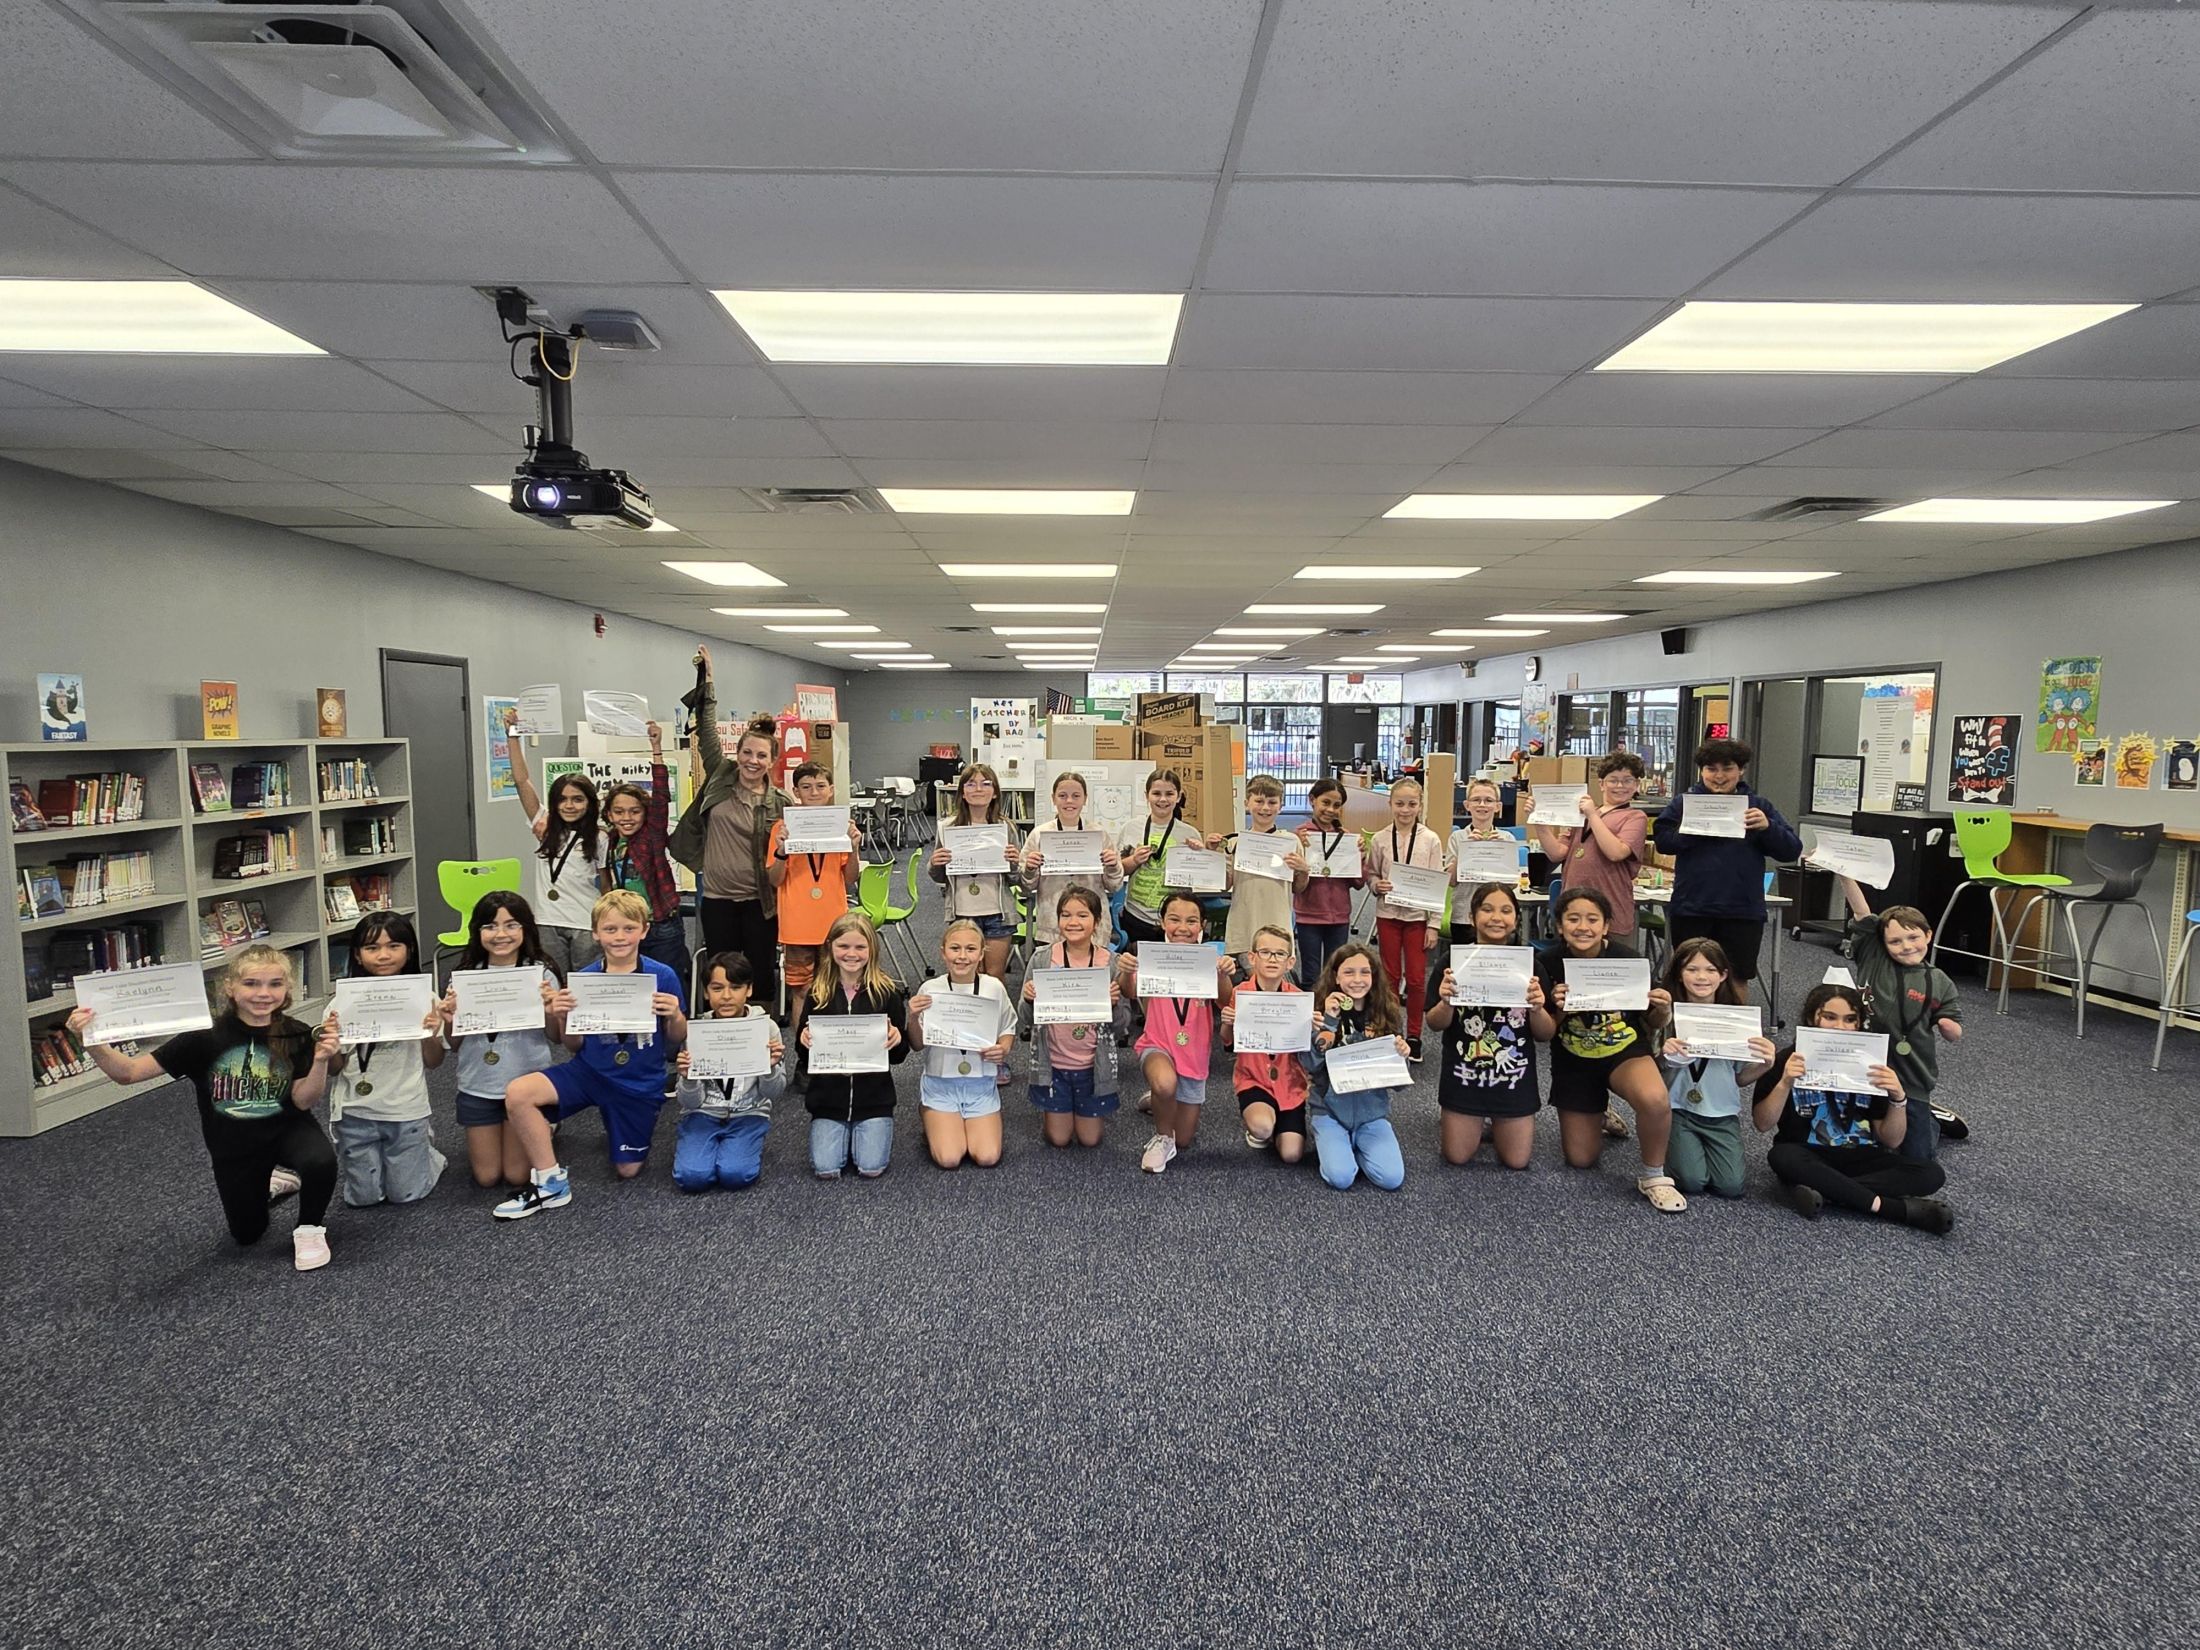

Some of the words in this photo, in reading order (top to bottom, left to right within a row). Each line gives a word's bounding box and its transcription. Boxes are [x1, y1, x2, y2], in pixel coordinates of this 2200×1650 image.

[208, 695, 232, 712] POW!
[1145, 702, 1175, 717] BOARD
[1176, 698, 1190, 709] KIT
[587, 763, 611, 778] THE
